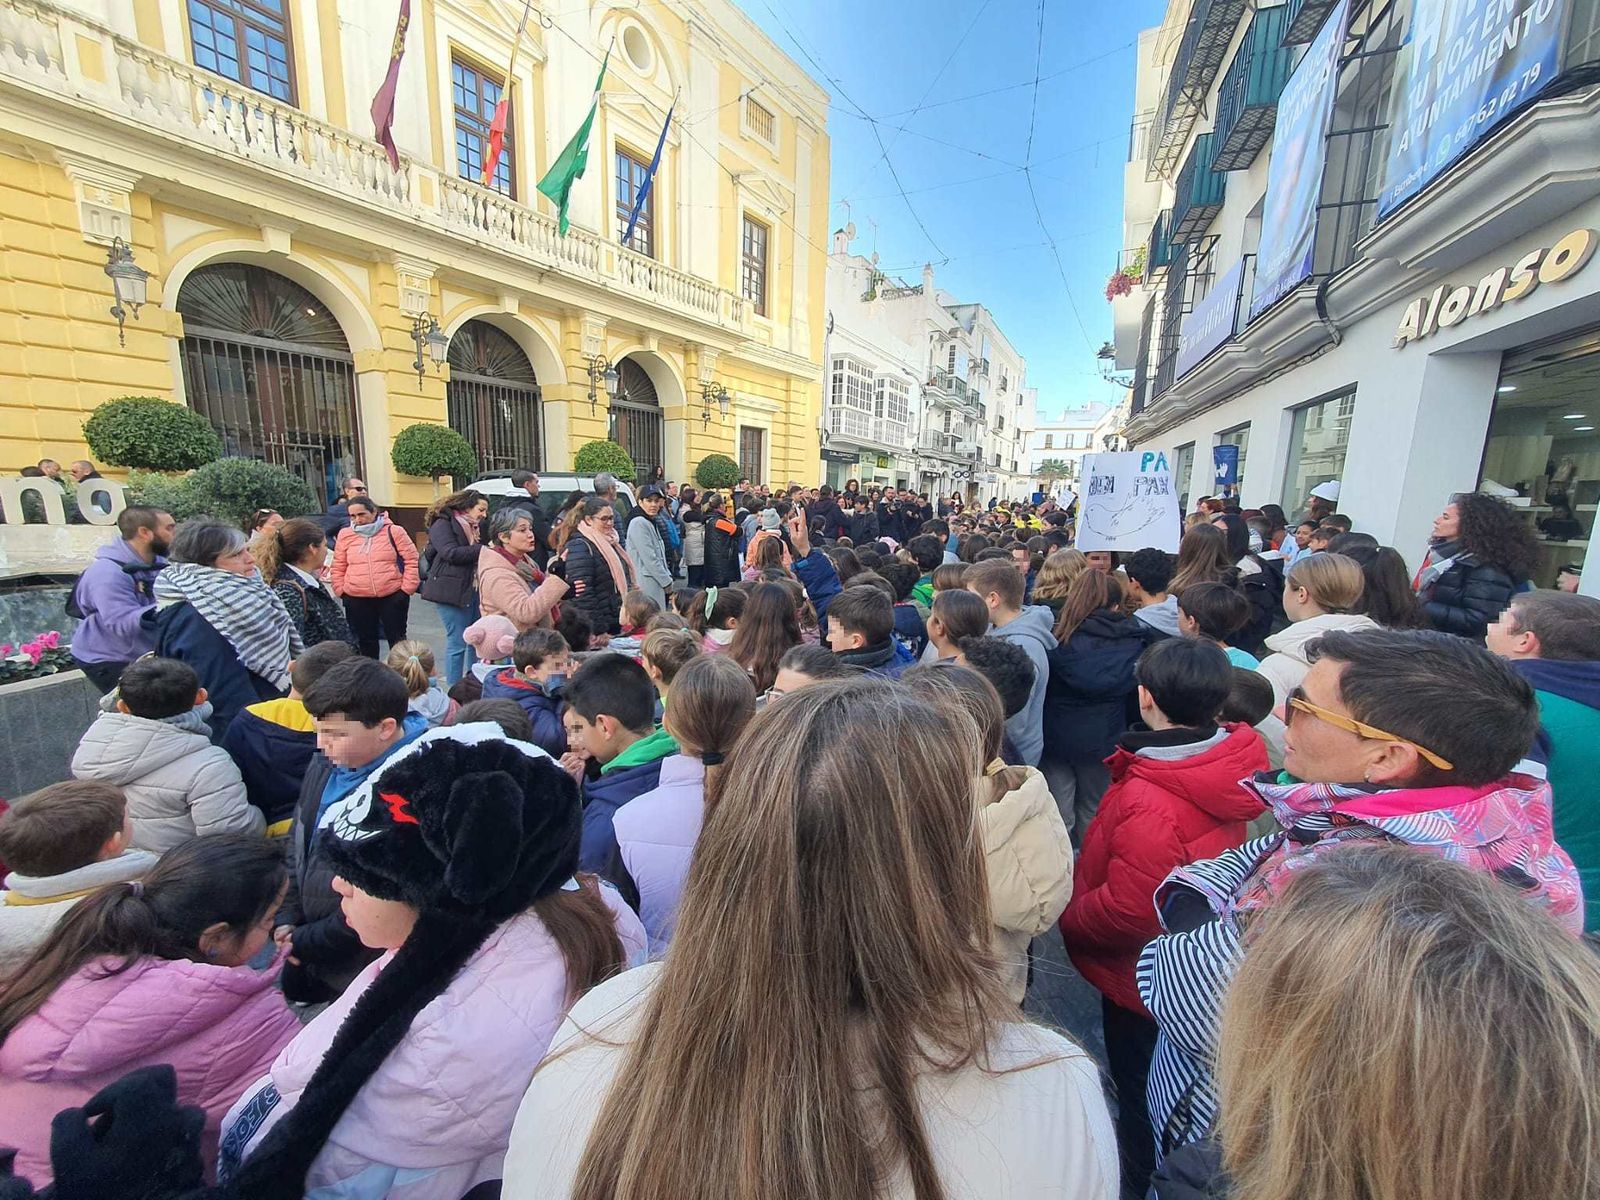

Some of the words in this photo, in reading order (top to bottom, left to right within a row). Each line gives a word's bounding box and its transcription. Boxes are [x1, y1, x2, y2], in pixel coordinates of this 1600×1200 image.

[1407, 72, 1430, 120] TU
[1436, 15, 1480, 90] VOZ
[1476, 97, 1498, 124] 62
[1499, 81, 1518, 107] 02
[1521, 62, 1541, 91] 79
[1390, 228, 1597, 349] Alonso
